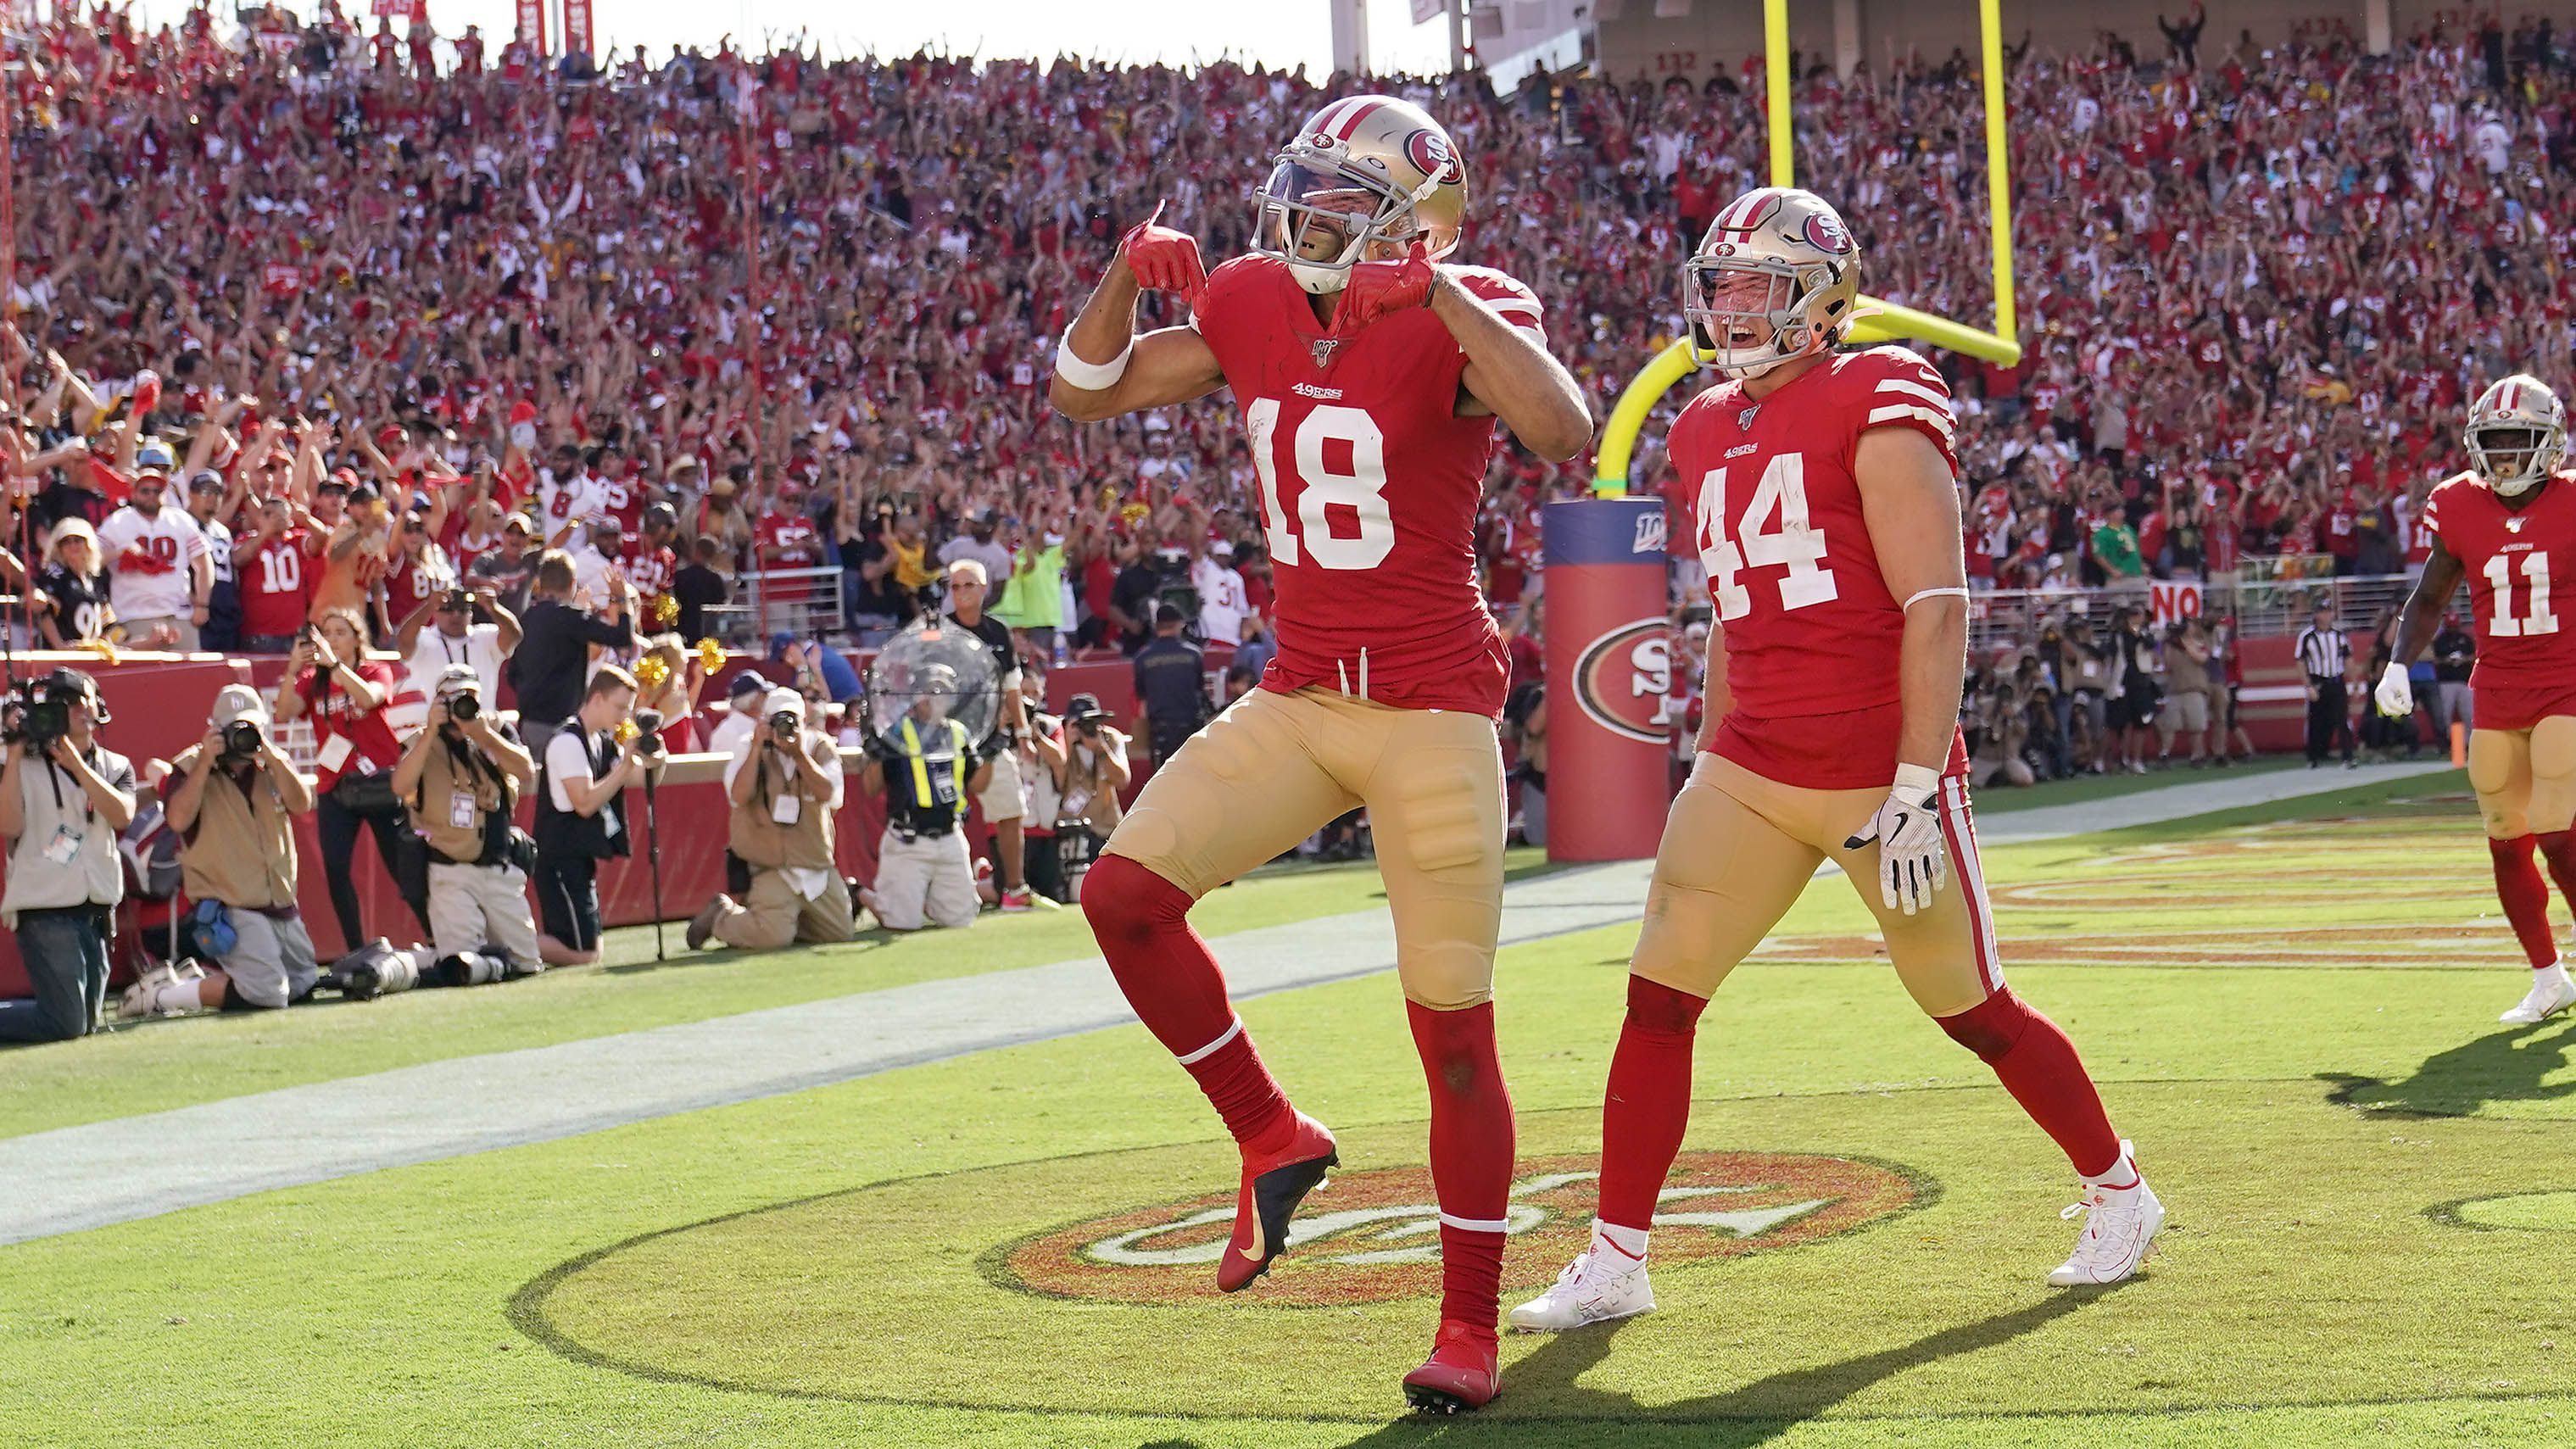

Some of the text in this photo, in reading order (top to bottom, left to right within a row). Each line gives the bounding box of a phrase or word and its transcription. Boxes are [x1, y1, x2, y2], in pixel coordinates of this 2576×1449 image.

[1291, 382, 1343, 399] 49ERS
[1246, 397, 1396, 570] 18
[259, 545, 300, 593] 10
[1696, 452, 1838, 621] 44
[2152, 586, 2200, 623] NO
[2483, 551, 2559, 636] 11
